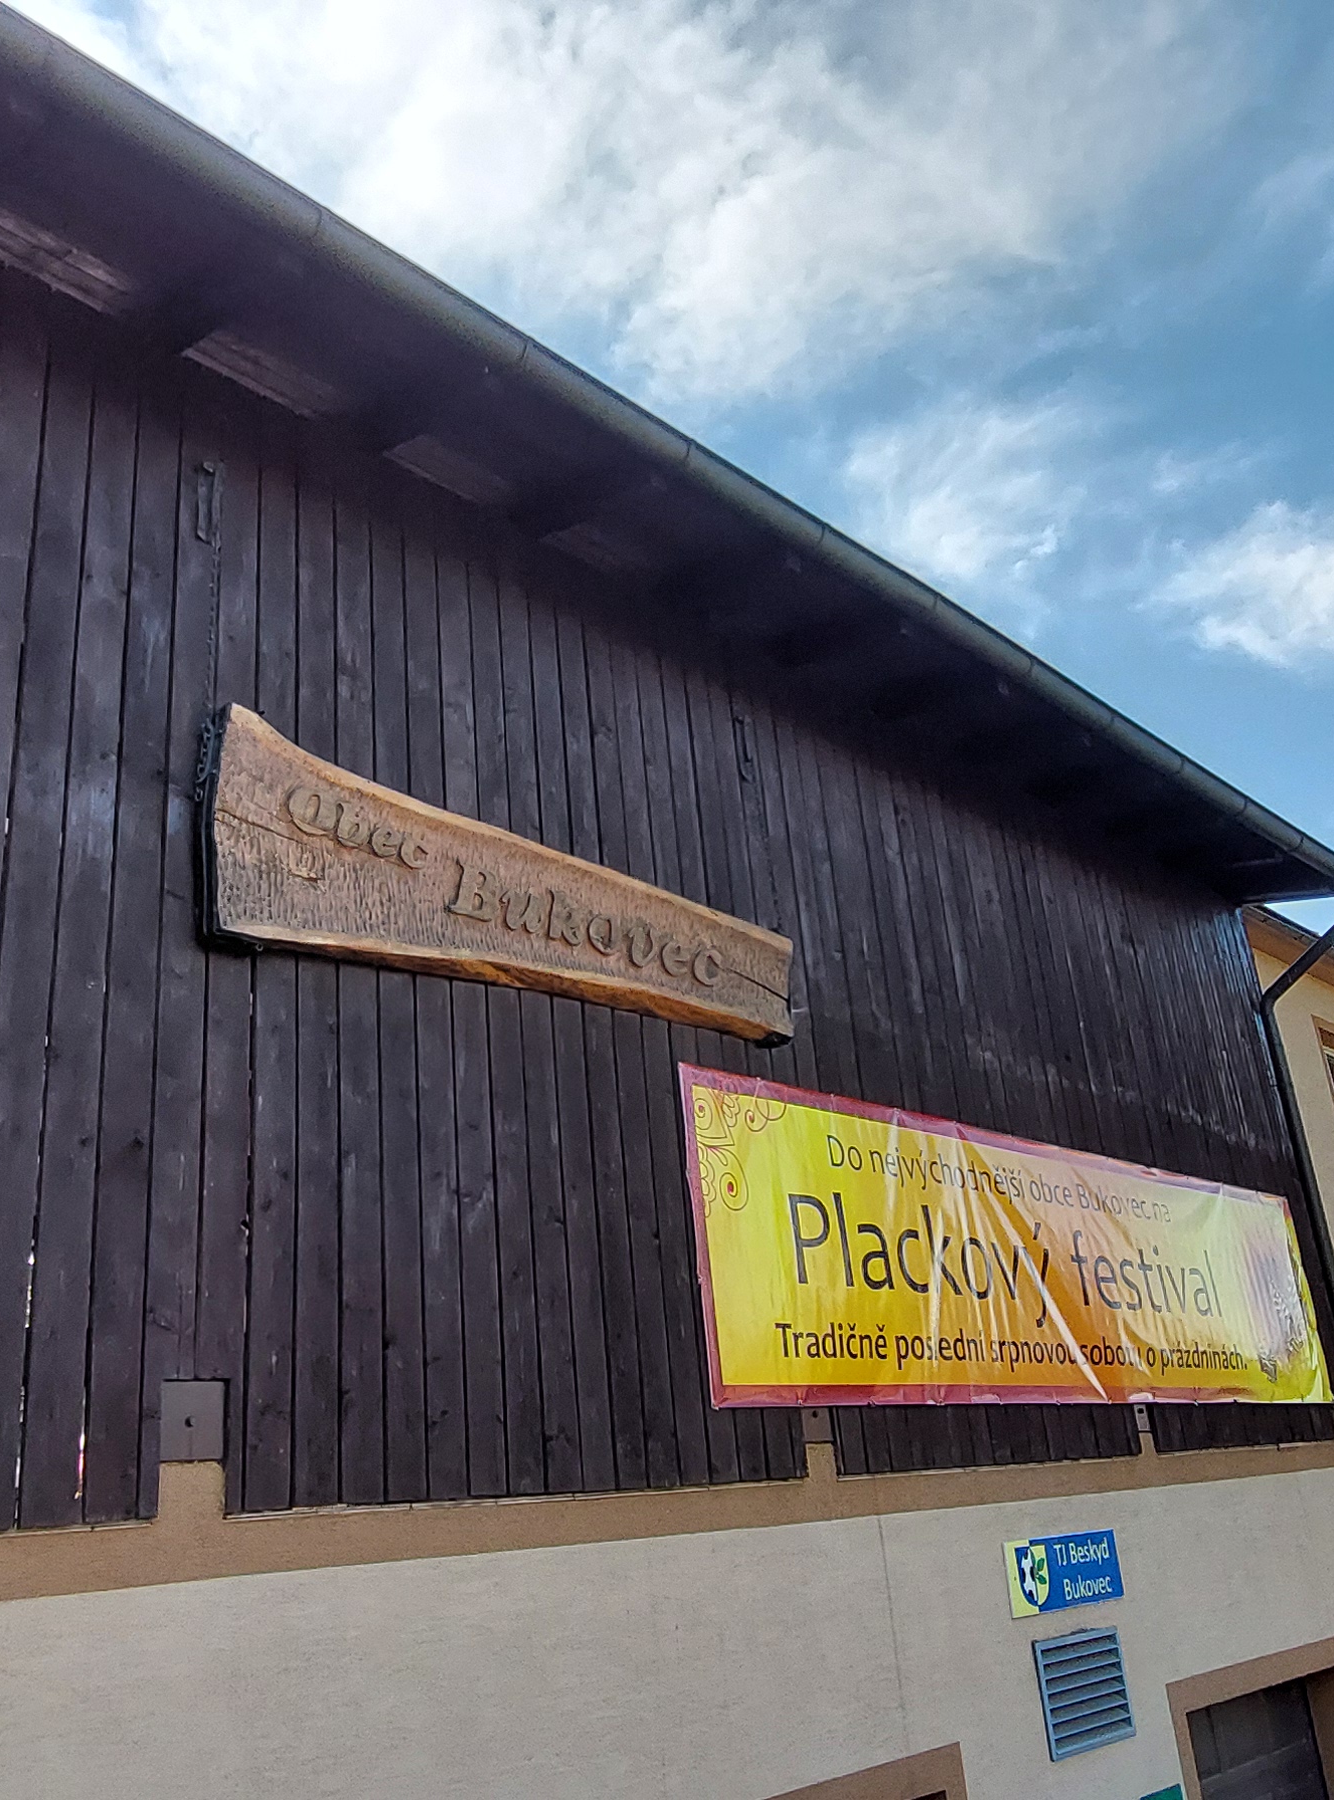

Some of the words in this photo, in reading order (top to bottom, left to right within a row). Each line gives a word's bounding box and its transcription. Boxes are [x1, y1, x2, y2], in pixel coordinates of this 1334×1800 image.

[286, 784, 429, 869] Obec
[444, 856, 725, 987] Bukovec
[826, 1134, 863, 1171] Do
[868, 1147, 1026, 1205] nejvýchodnější
[1029, 1173, 1074, 1207] obce
[1075, 1182, 1152, 1220] Bukovec
[1152, 1202, 1172, 1223] na
[787, 1191, 1050, 1329] Plackový
[1070, 1229, 1223, 1317] festival
[774, 1321, 888, 1360] Tradičně
[894, 1327, 986, 1371] poslední
[989, 1339, 1082, 1373] srpnovou
[1146, 1346, 1156, 1368] o
[1160, 1340, 1248, 1377] prázdninách.
[1053, 1543, 1068, 1567] TJ
[1068, 1536, 1110, 1566] Beskyd
[1063, 1574, 1113, 1601] Bukovec
